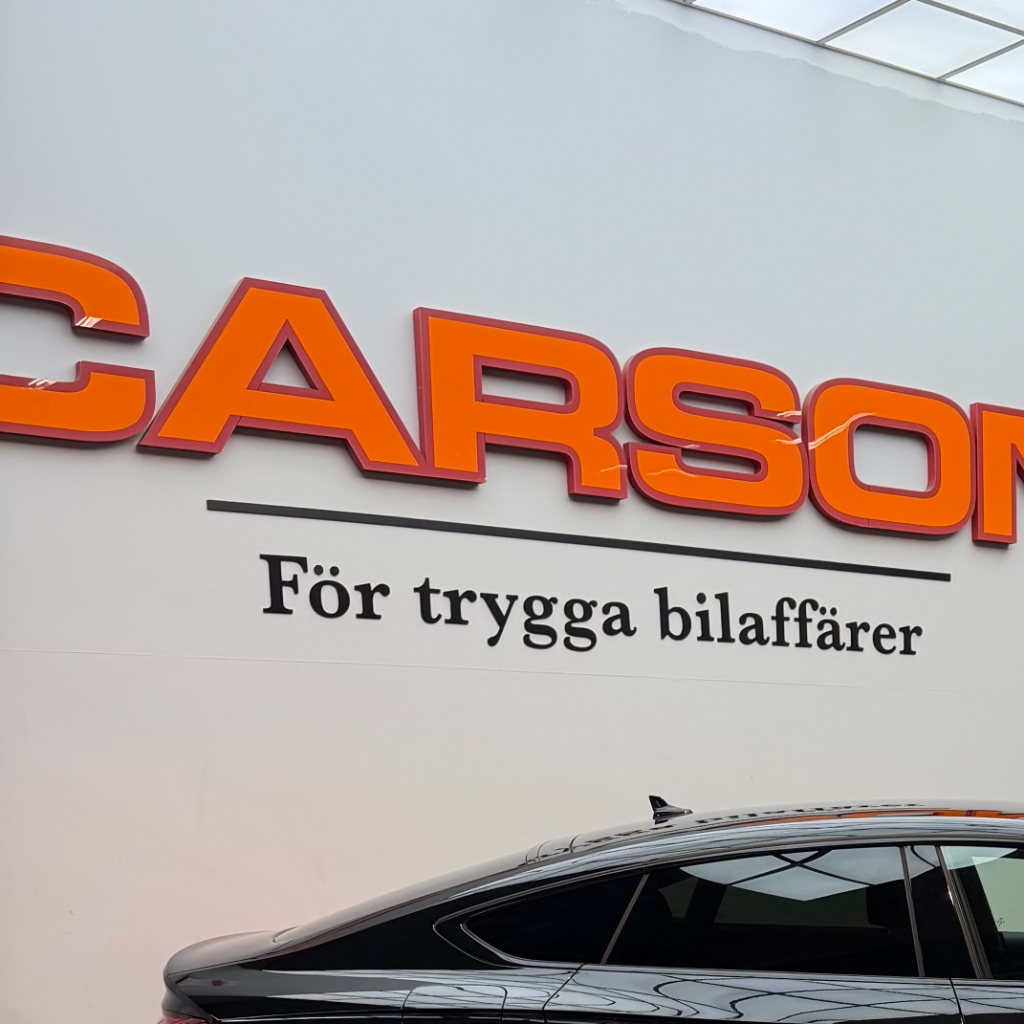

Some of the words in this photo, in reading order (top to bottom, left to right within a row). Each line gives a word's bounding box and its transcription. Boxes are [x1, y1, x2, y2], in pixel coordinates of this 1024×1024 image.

[259, 554, 391, 620] För
[413, 577, 637, 652] trygga
[653, 586, 923, 656] bilaffärer
